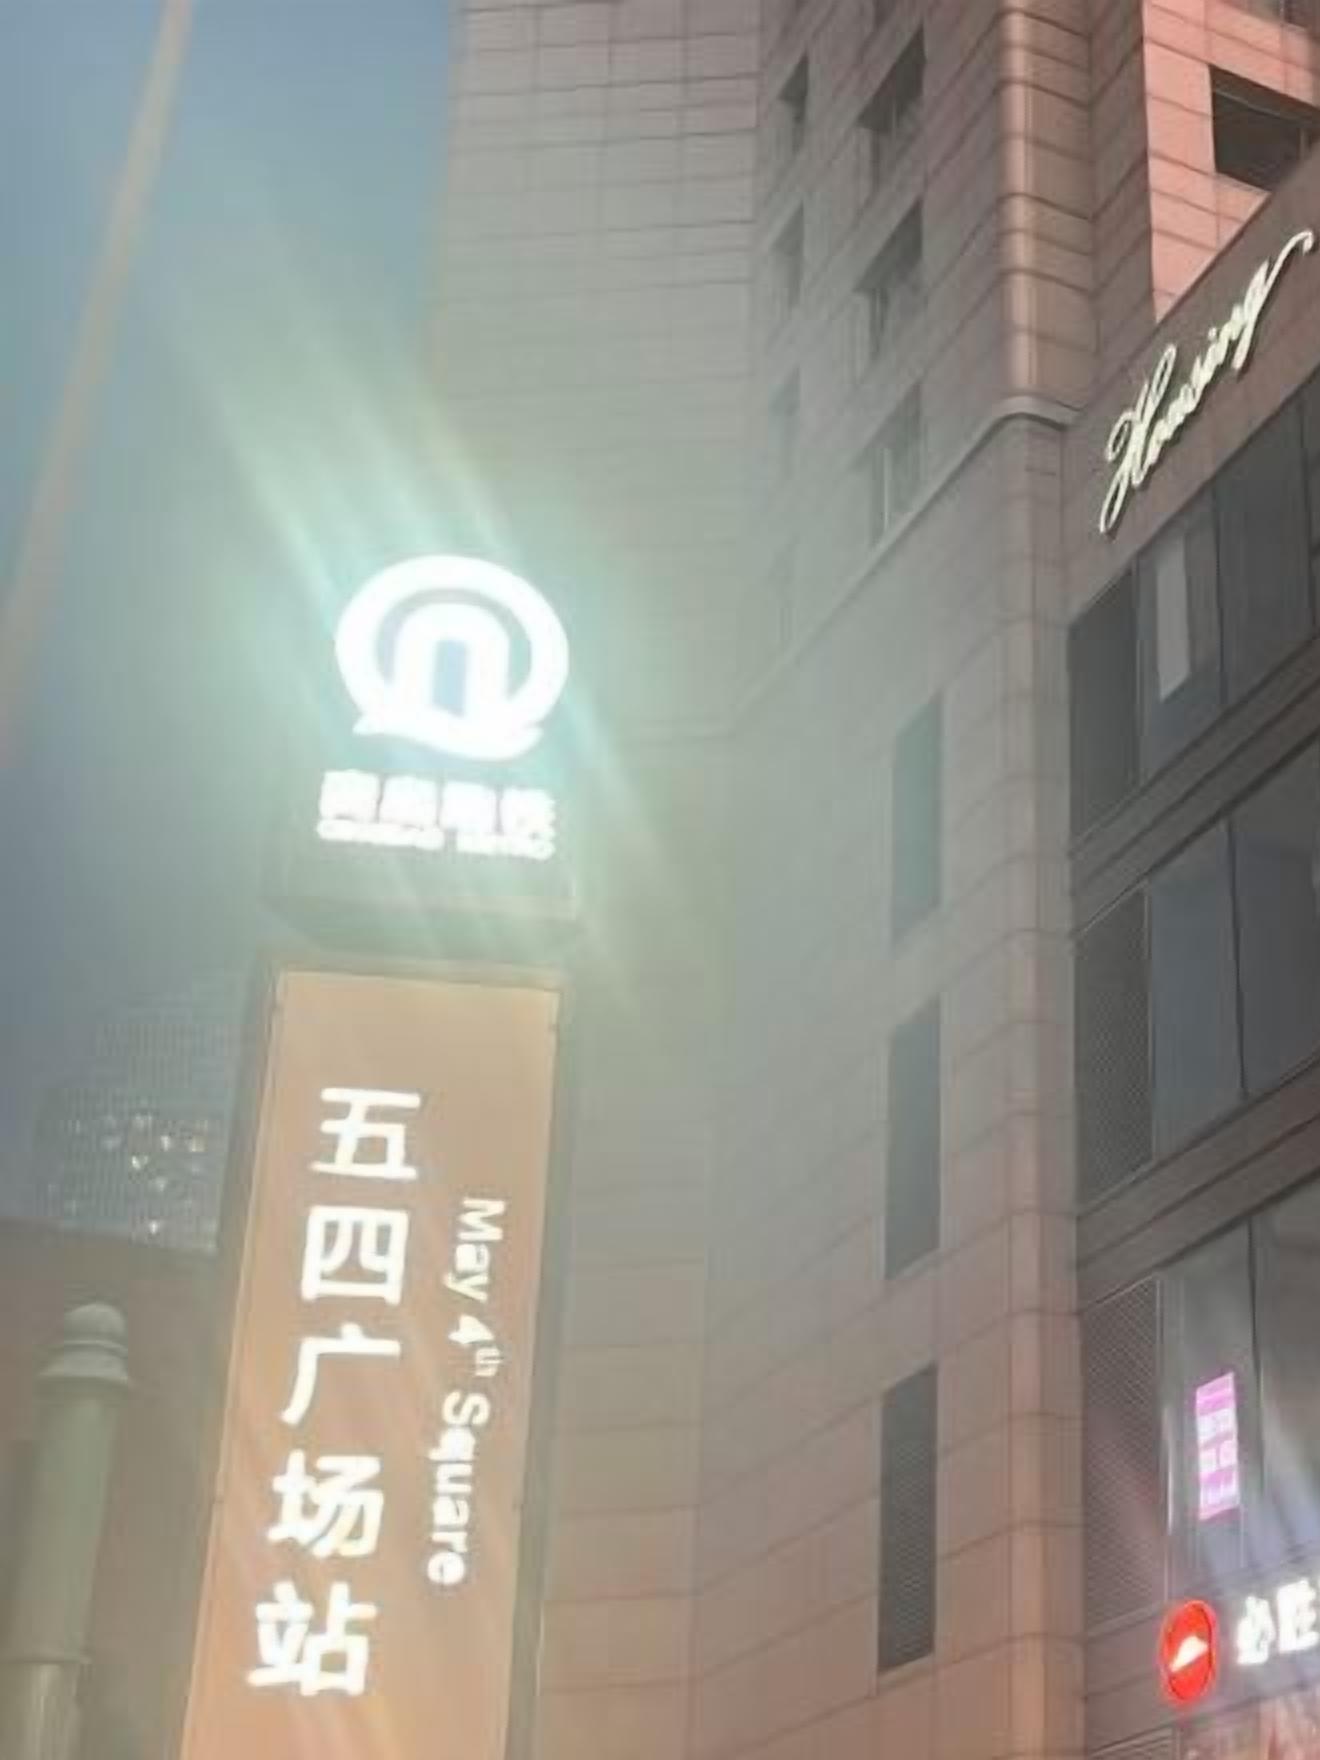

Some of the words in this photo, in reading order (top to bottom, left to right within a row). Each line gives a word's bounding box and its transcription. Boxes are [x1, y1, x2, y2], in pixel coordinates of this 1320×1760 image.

[443, 1198, 506, 1302] May
[246, 1086, 421, 1697] 五四广场站
[449, 1314, 502, 1377] 4th
[428, 1391, 491, 1584] Square
